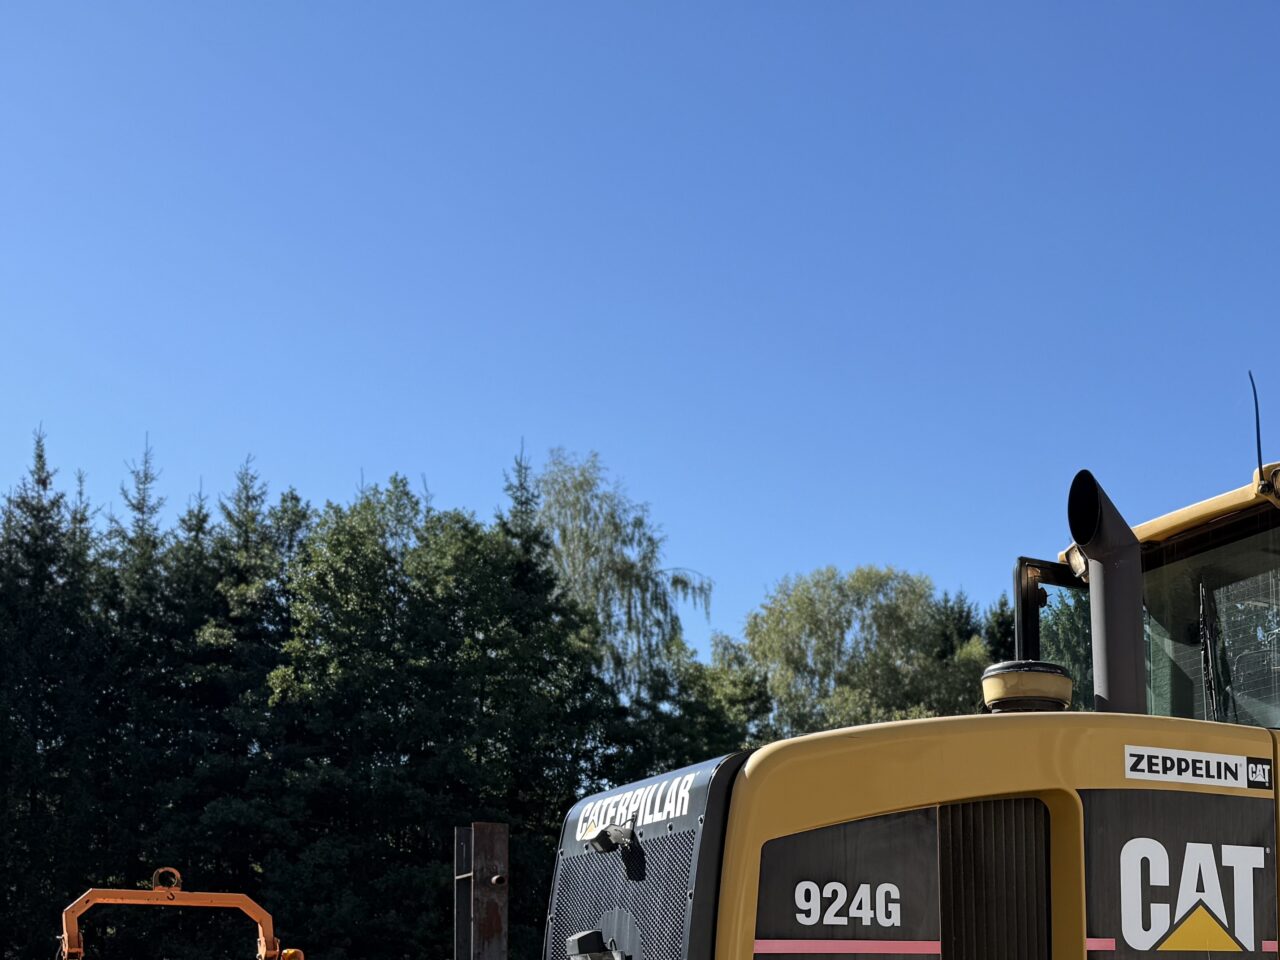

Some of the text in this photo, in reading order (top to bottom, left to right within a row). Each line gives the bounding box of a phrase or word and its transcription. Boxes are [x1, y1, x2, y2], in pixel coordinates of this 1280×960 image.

[1129, 753, 1270, 783] ZEPPELIN CAT
[576, 773, 696, 841] CATERPILLAR
[795, 880, 901, 927] 924G
[1120, 837, 1265, 952] CAT
